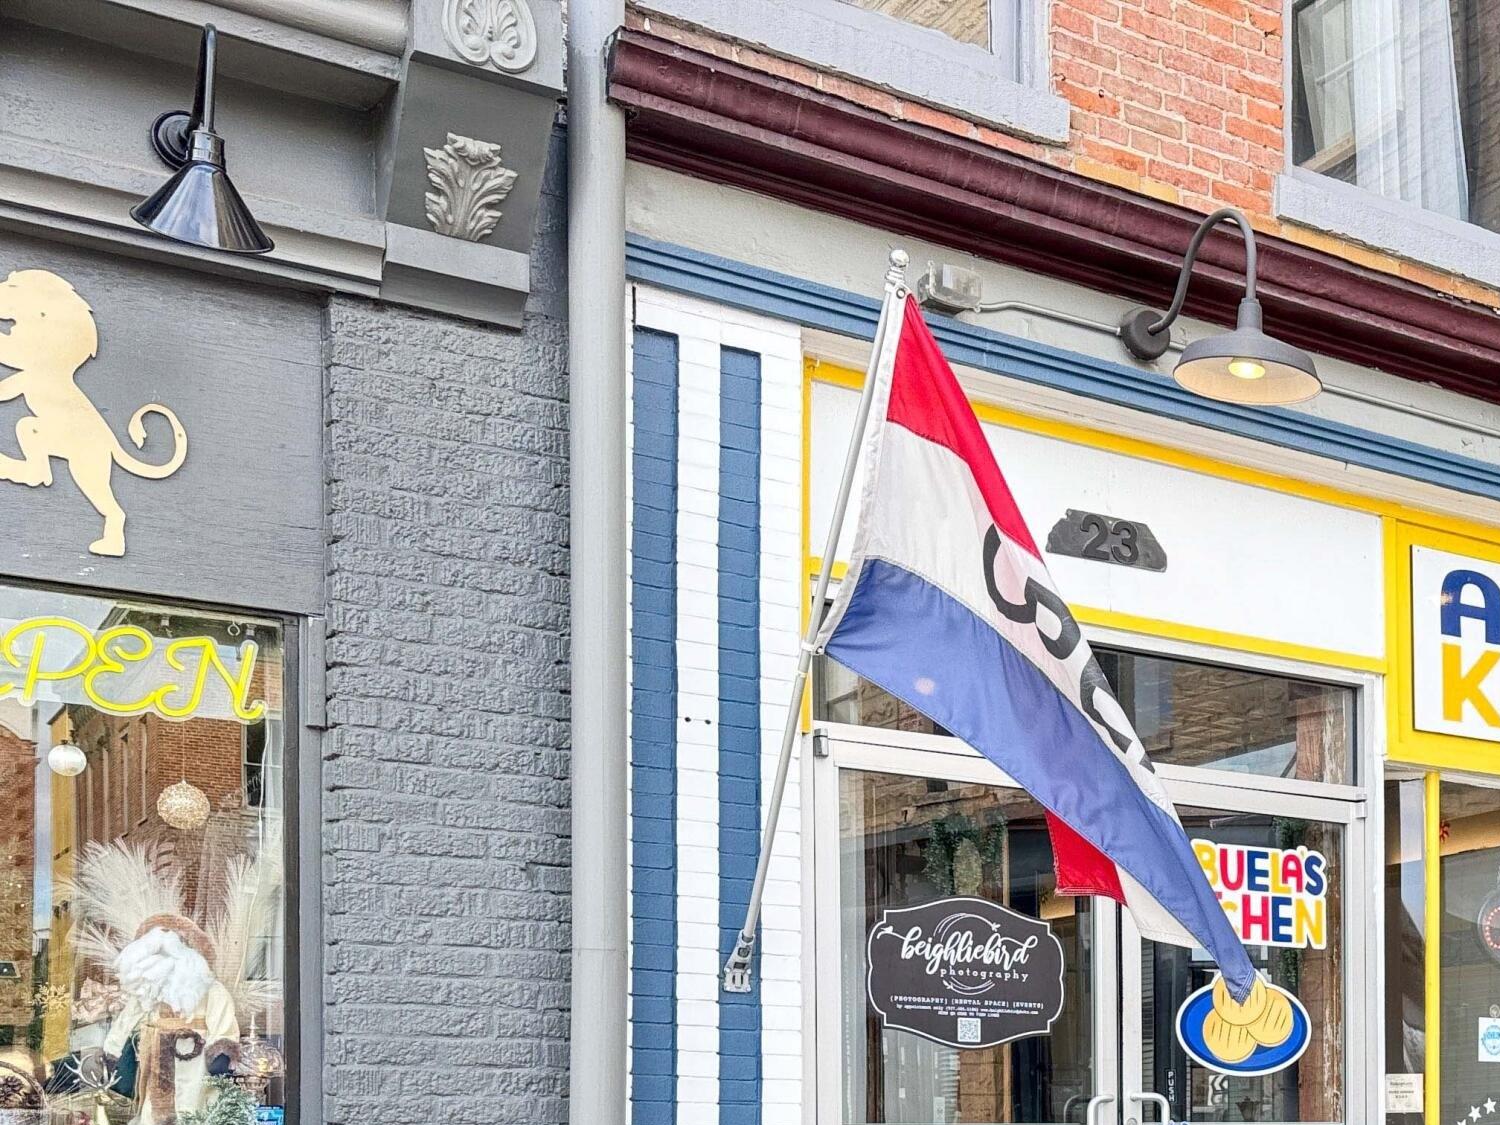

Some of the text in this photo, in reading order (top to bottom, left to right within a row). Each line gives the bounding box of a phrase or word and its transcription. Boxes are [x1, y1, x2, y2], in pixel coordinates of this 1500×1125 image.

[1080, 513, 1139, 565] 23
[0, 616, 266, 721] PEN
[1194, 843, 1324, 896] BUELA'S
[901, 926, 1038, 975] beighliebird
[940, 966, 1029, 982] photography
[1167, 1071, 1175, 1102] PUSH
